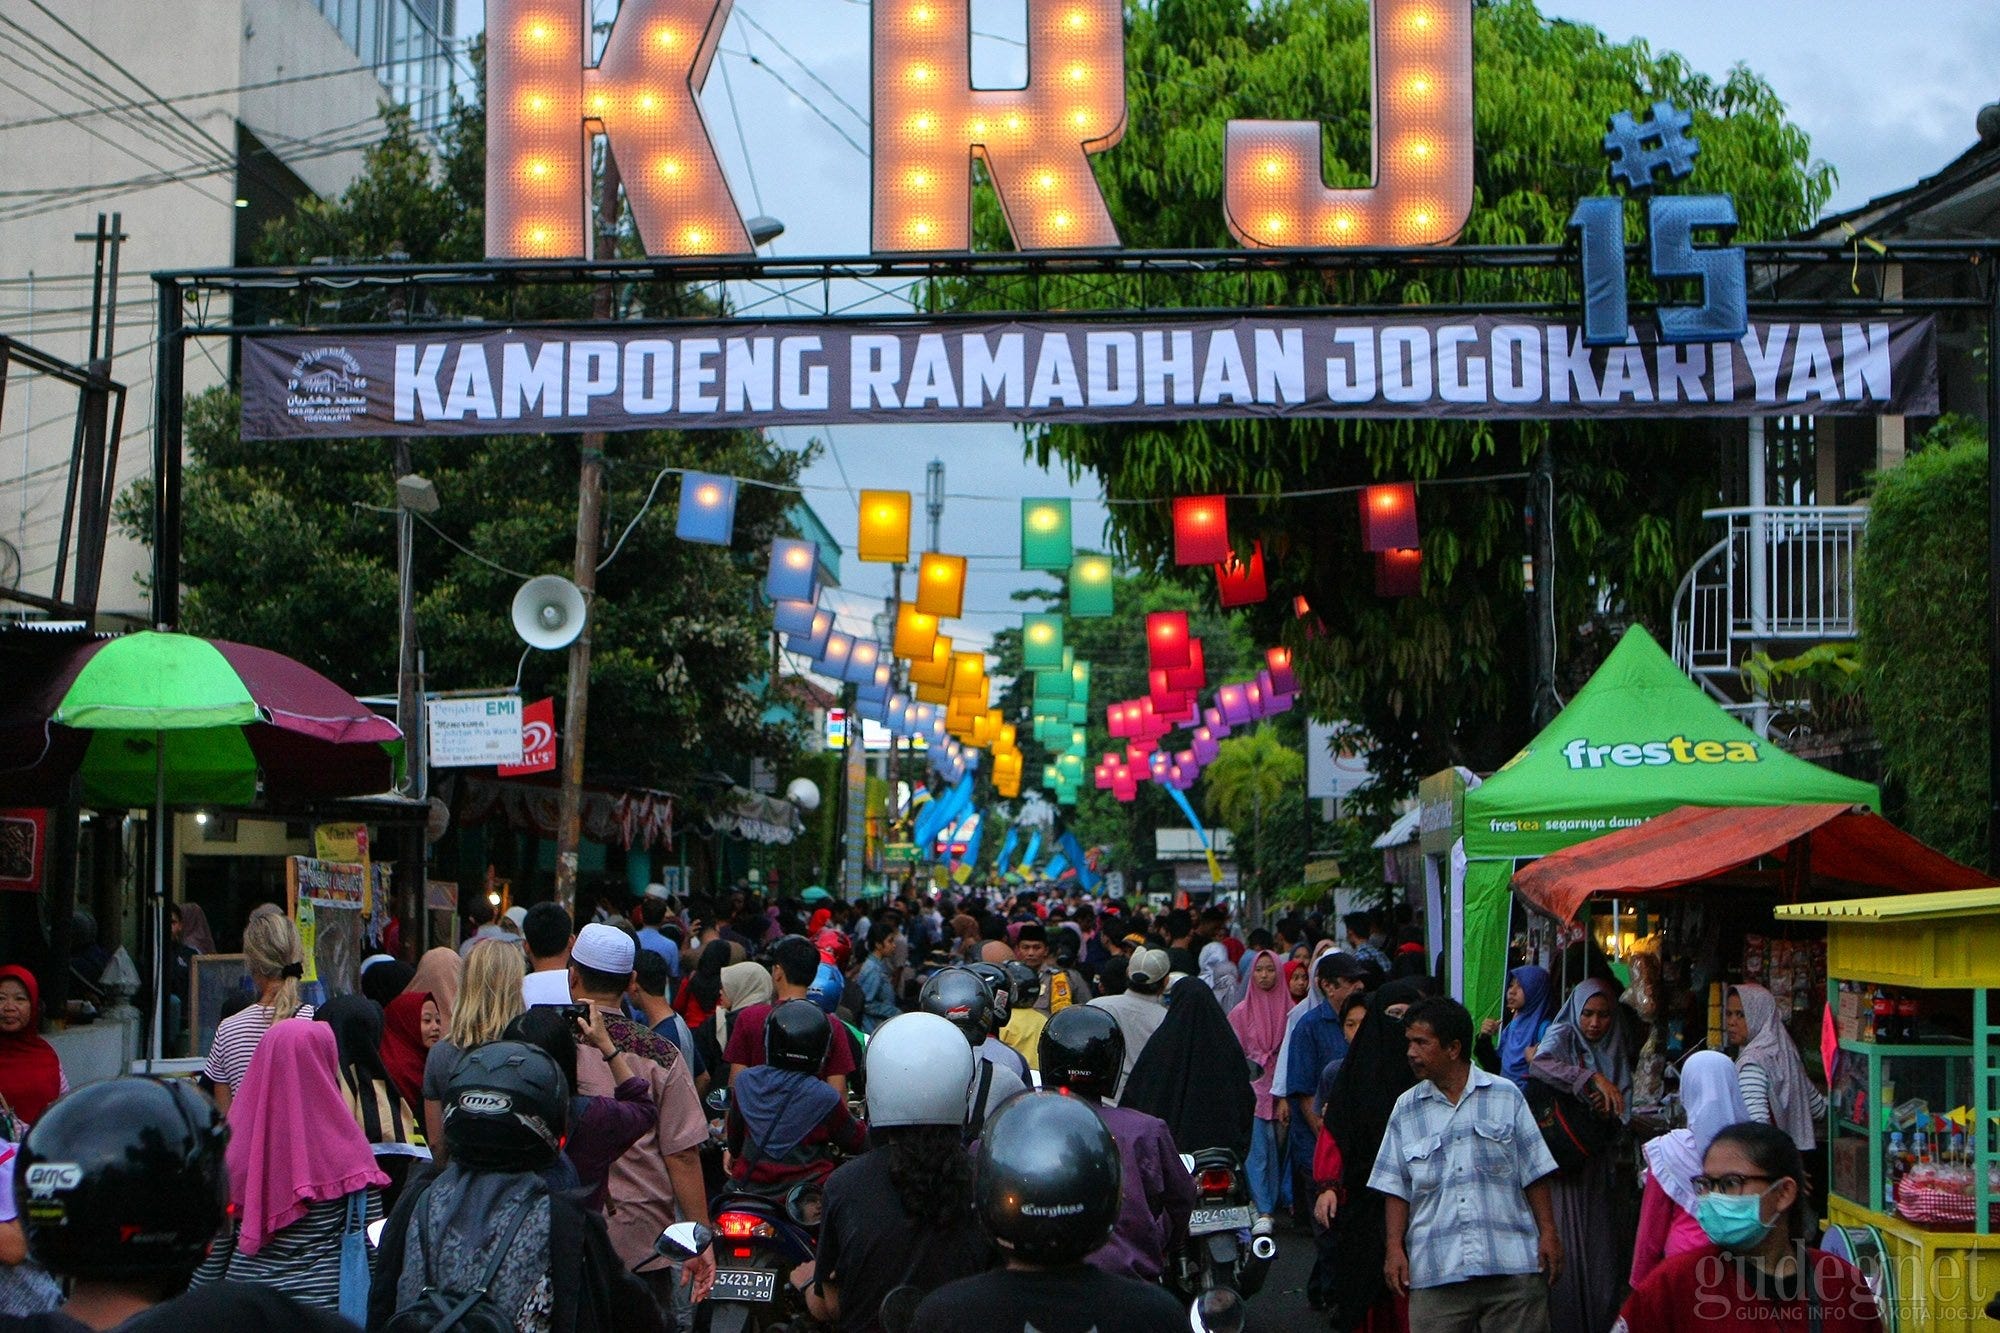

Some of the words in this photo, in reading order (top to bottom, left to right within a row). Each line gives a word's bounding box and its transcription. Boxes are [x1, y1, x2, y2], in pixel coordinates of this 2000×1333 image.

[394, 336, 829, 420] KAMPOENG
[850, 328, 1306, 409] RAMADHAN
[1326, 323, 1891, 402] JOGOKARIYAN
[485, 700, 516, 716] EMI
[1566, 736, 1757, 769] frestea
[1489, 818, 1540, 832] frestea
[1545, 818, 1606, 833] segarnya
